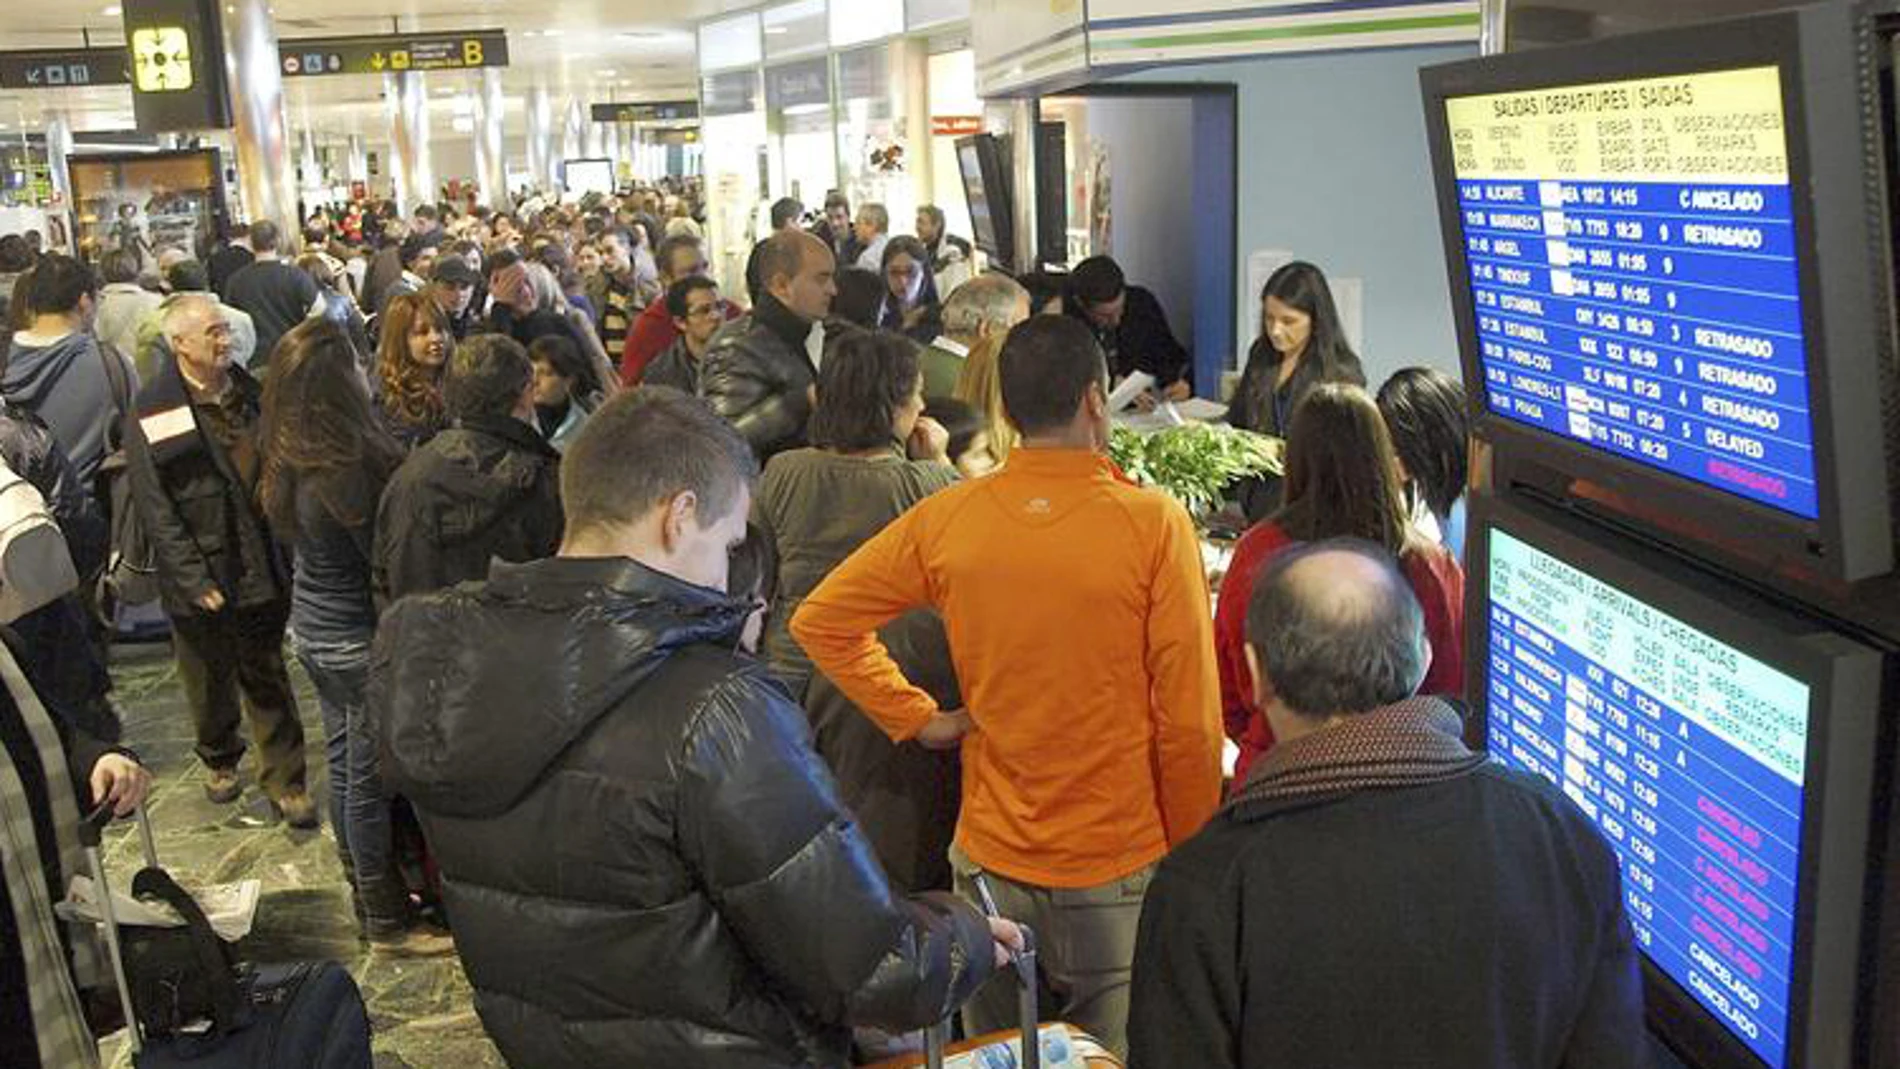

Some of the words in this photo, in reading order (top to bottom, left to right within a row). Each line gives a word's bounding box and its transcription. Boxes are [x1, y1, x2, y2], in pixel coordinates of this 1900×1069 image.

[463, 40, 484, 66] B
[1492, 96, 1538, 118] SALIDAS
[1545, 87, 1629, 115] DEPARTURES
[1695, 132, 1757, 152] REMARKS
[1683, 225, 1762, 248] RETRASADO
[1695, 328, 1773, 358] RETRASADO
[1698, 362, 1776, 394] RETRASADO
[1678, 390, 1687, 406] 4
[1702, 396, 1779, 429] RETRASADO
[1705, 427, 1764, 458] DELAYED
[1530, 551, 1584, 594] LLEGADAS
[1592, 582, 1651, 630] ARRIVALS
[1659, 616, 1739, 676] CHEGADAS
[1678, 722, 1688, 739] A
[1724, 696, 1780, 743] REMARKS
[1676, 750, 1686, 767] A
[1690, 943, 1759, 1009] CANCELADO
[1689, 971, 1757, 1038] CANCELADO
